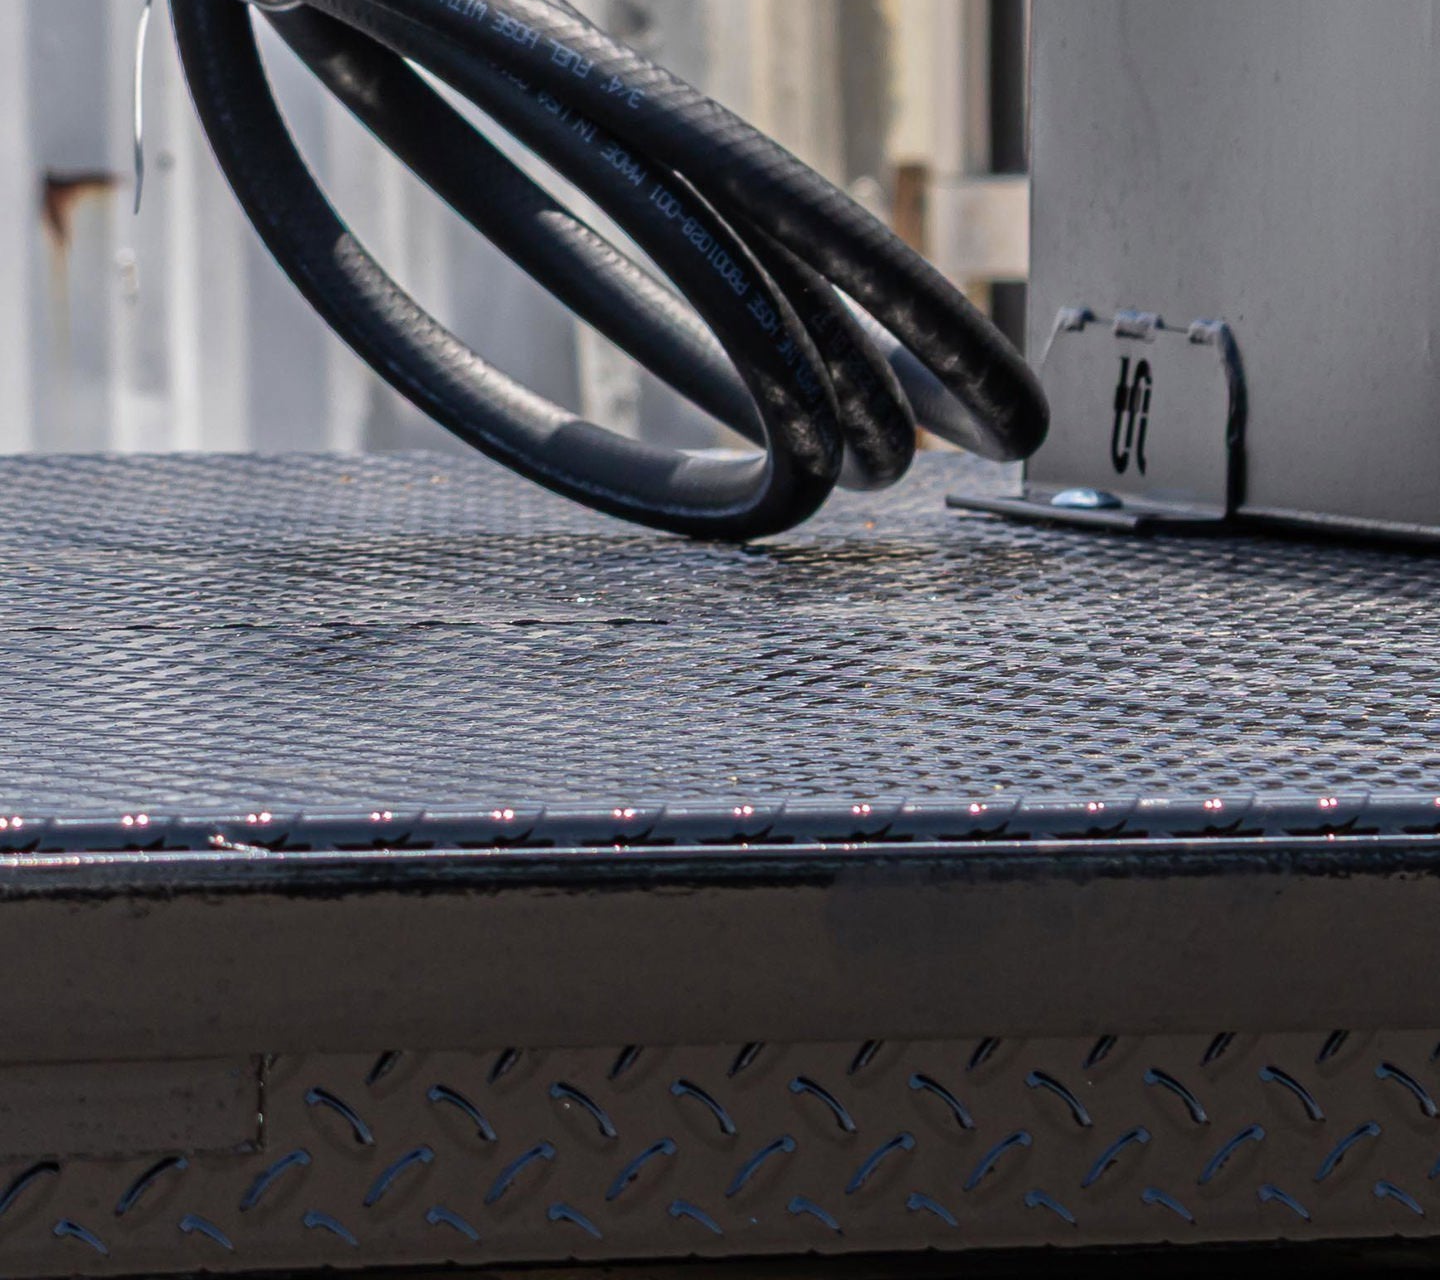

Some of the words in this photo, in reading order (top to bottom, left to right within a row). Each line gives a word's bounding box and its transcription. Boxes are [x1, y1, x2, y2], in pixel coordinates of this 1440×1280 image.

[491, 11, 541, 49] HOSE
[549, 38, 595, 79] FUEL
[601, 146, 648, 187] MADE
